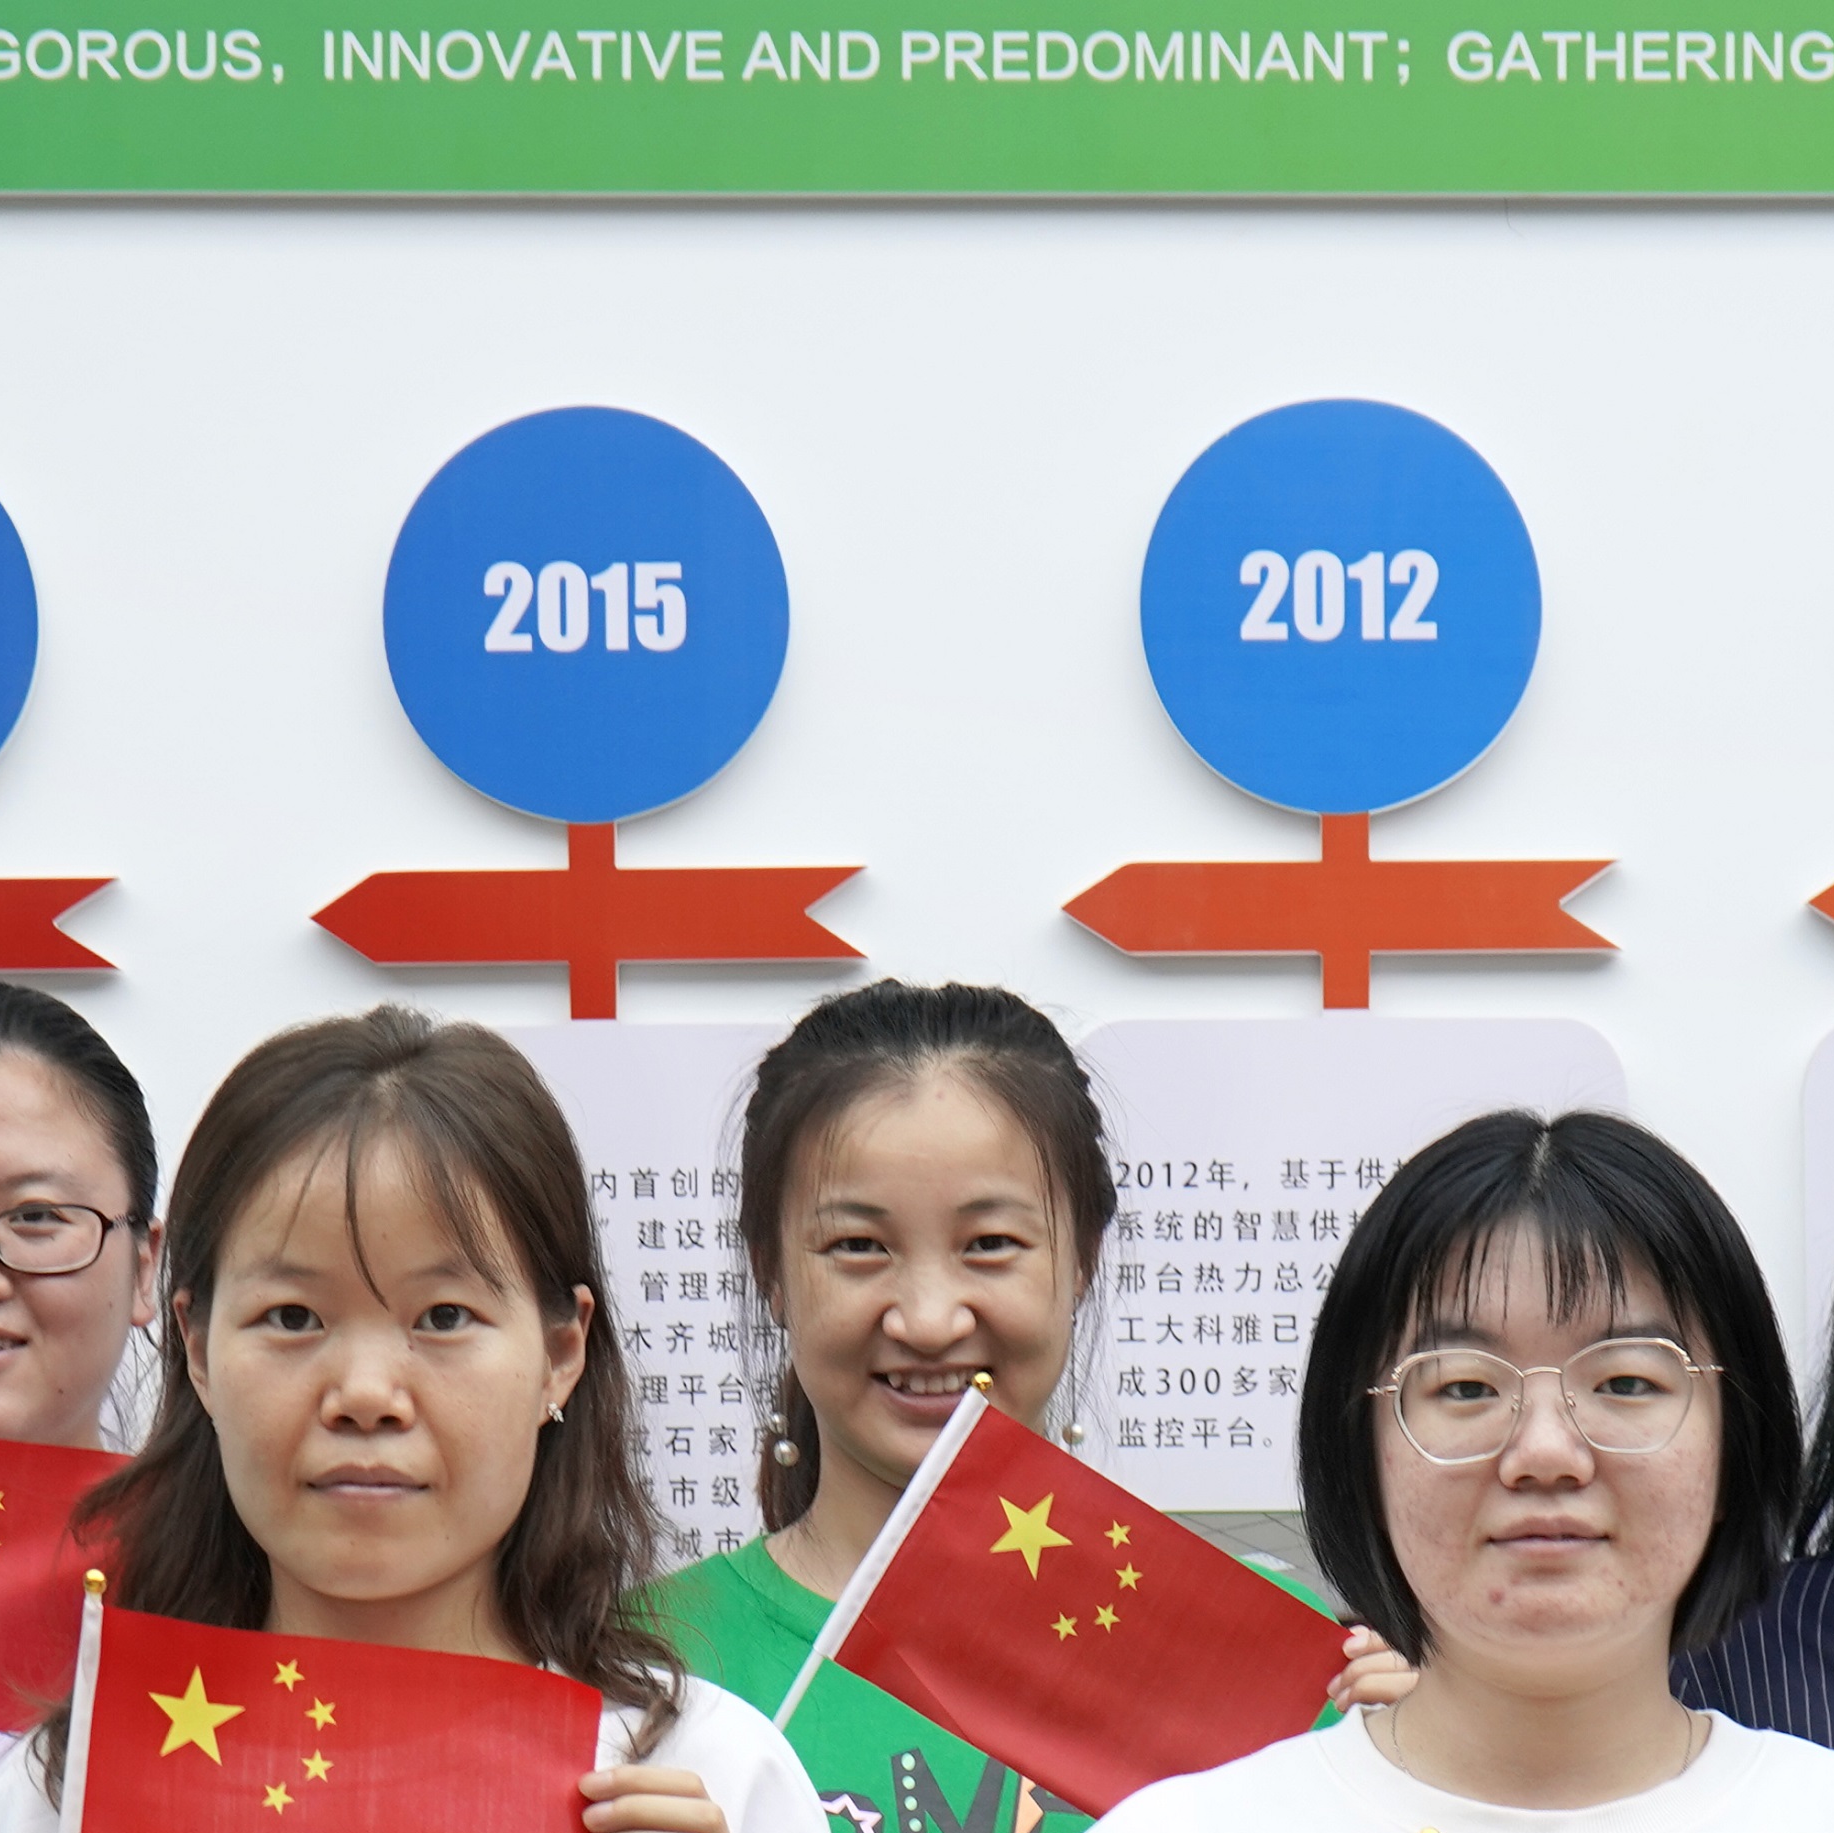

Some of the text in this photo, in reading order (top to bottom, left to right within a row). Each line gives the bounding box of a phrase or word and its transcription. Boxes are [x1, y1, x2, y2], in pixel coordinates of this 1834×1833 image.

[323, 30, 724, 82] INNOVATIVE
[741, 30, 881, 82] AND
[900, 30, 1410, 86] PREDOMINANT;
[482, 561, 688, 654] 2015
[1238, 549, 1441, 643] 2012
[1115, 1158, 1405, 1191] 2012年，基于供
[1116, 1312, 1320, 1345] 工大科雅已
[1116, 1364, 1298, 1398] 成300多家
